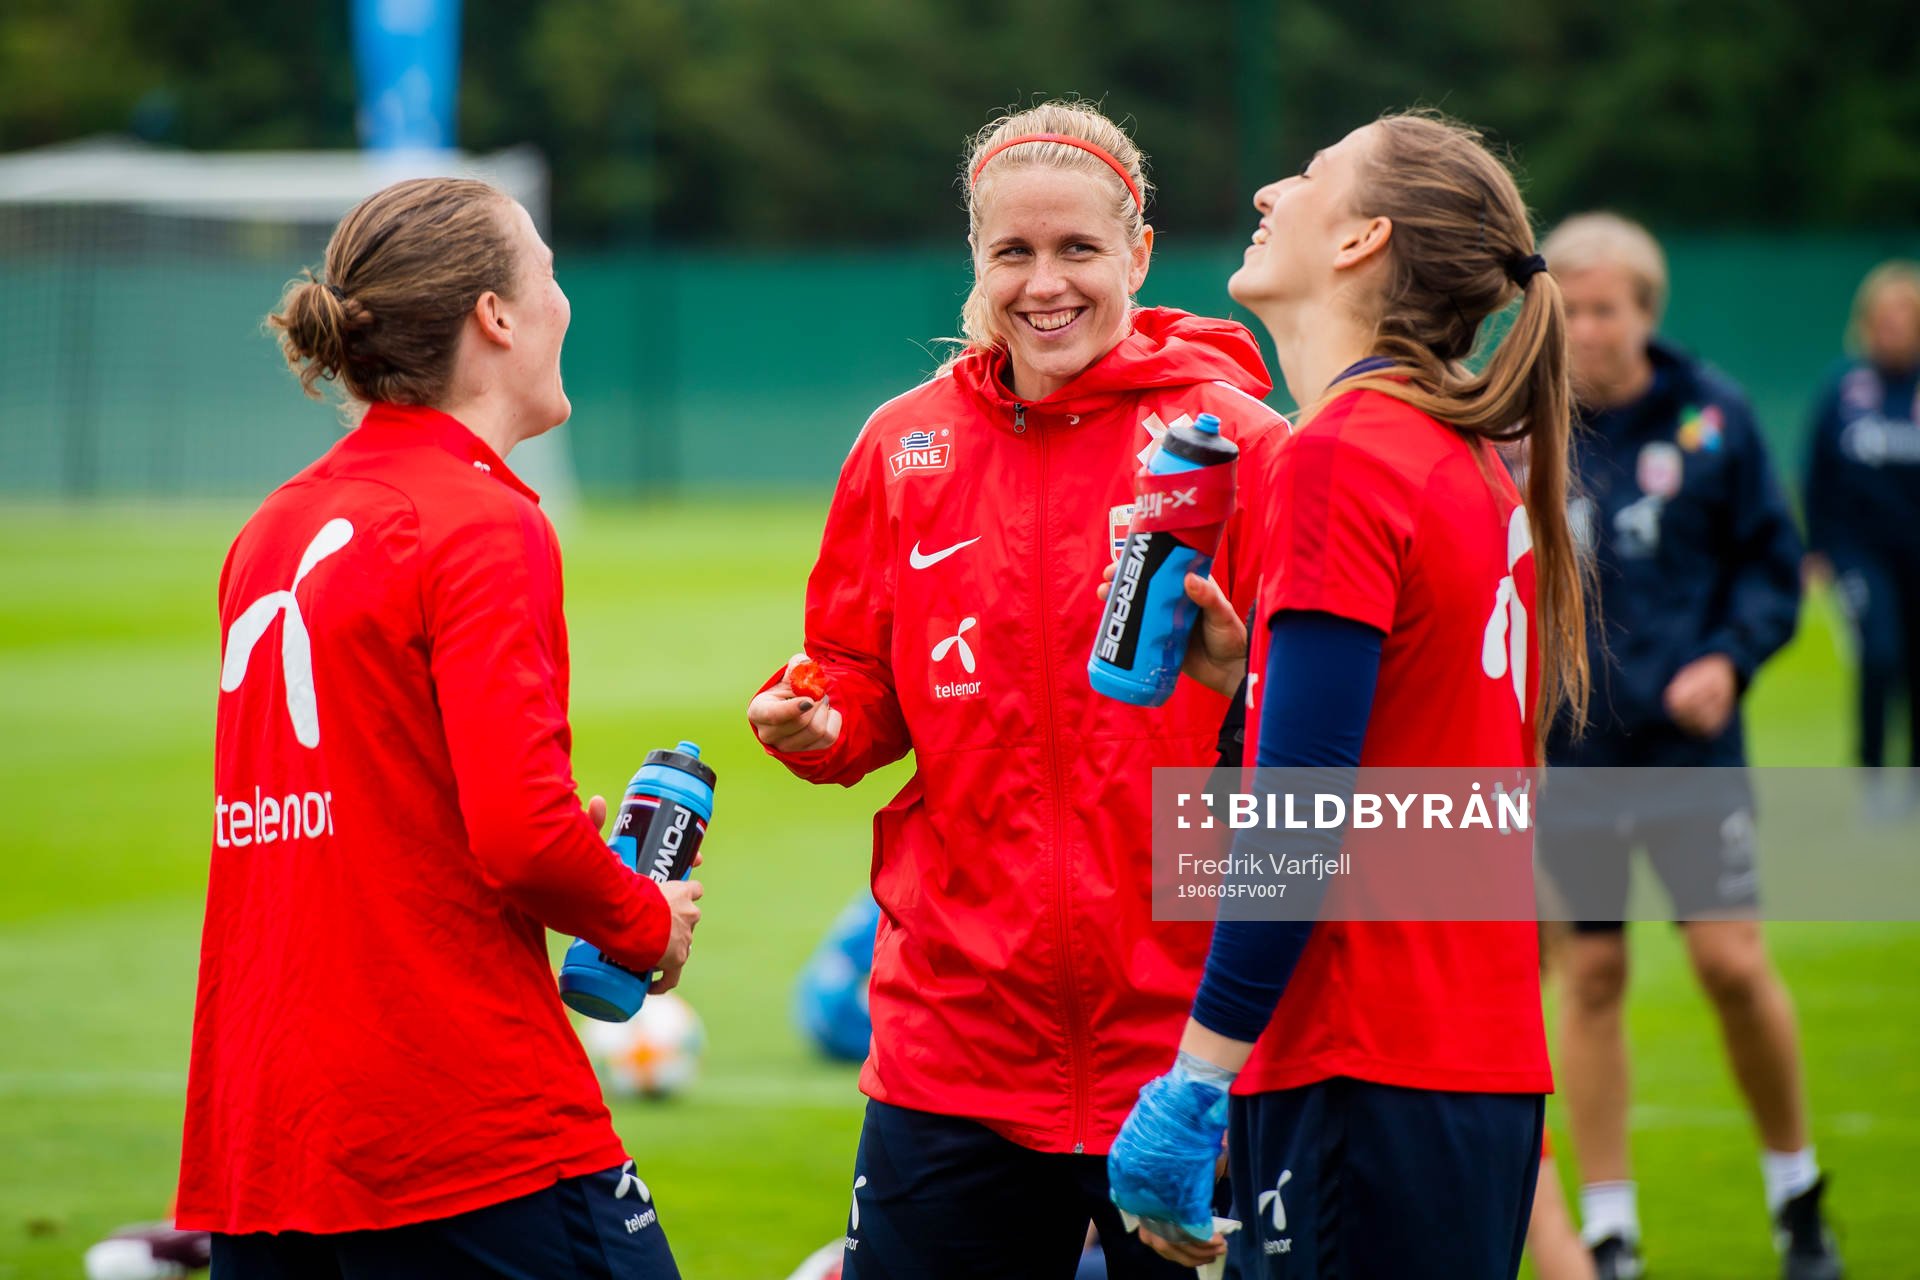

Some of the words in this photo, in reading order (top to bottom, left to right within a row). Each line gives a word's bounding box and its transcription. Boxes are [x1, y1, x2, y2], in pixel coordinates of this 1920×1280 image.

[895, 449, 942, 469] TINE
[934, 681, 981, 698] telenor
[216, 785, 334, 848] telenor
